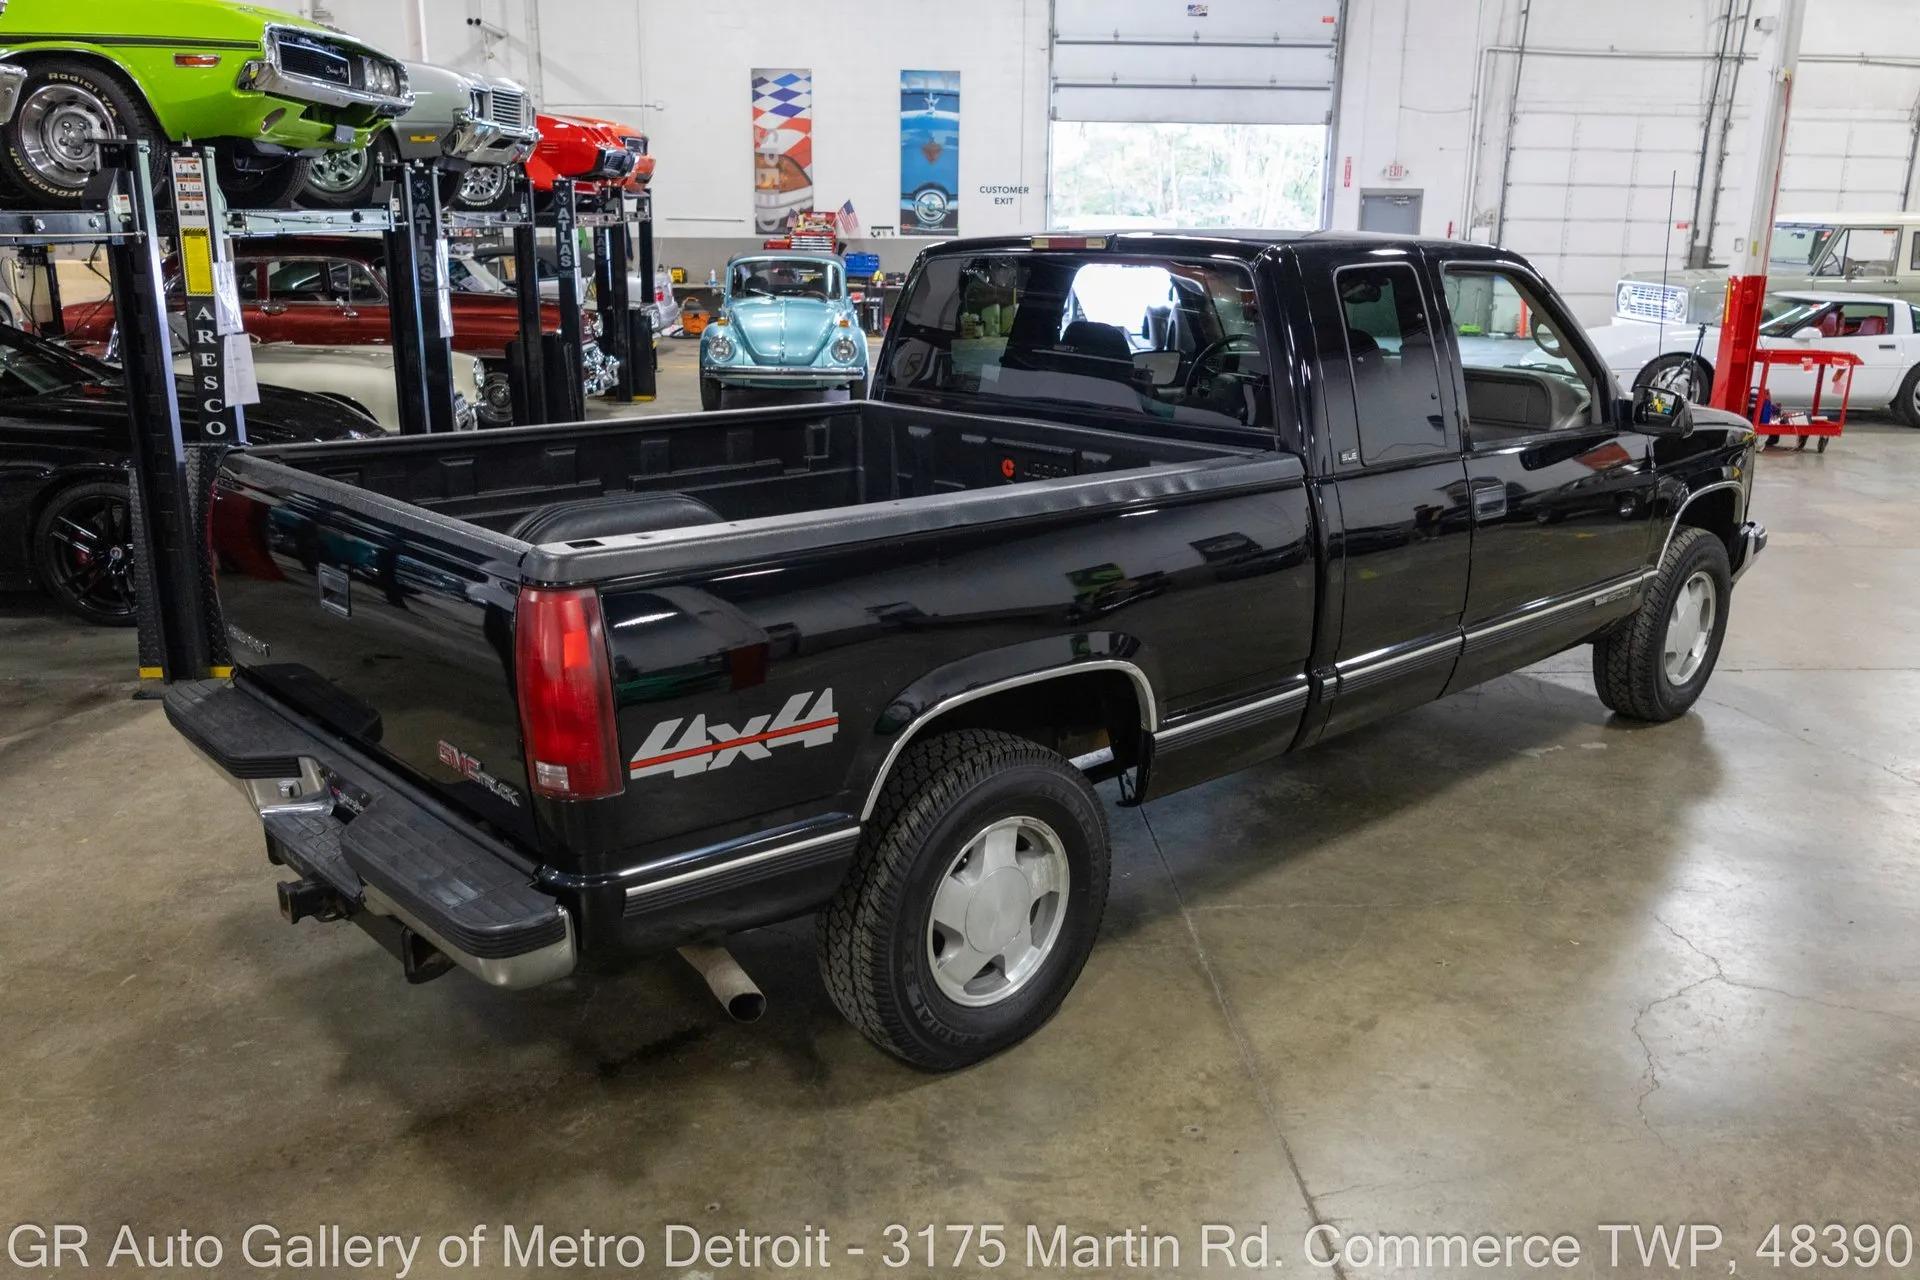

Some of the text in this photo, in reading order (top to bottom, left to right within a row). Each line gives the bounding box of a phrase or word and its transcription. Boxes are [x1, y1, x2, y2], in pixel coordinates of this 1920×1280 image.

[48, 72, 98, 93] Radial
[979, 186, 1030, 194] CUSTOMER
[1389, 165, 1404, 176] EXIT
[994, 197, 1014, 205] EXIT
[414, 202, 435, 282] ATLAS
[557, 207, 572, 267] ATLAS
[596, 207, 606, 256] ALAS
[195, 306, 226, 435] ARESCO
[630, 688, 839, 780] 4x4
[438, 740, 481, 783] GMC
